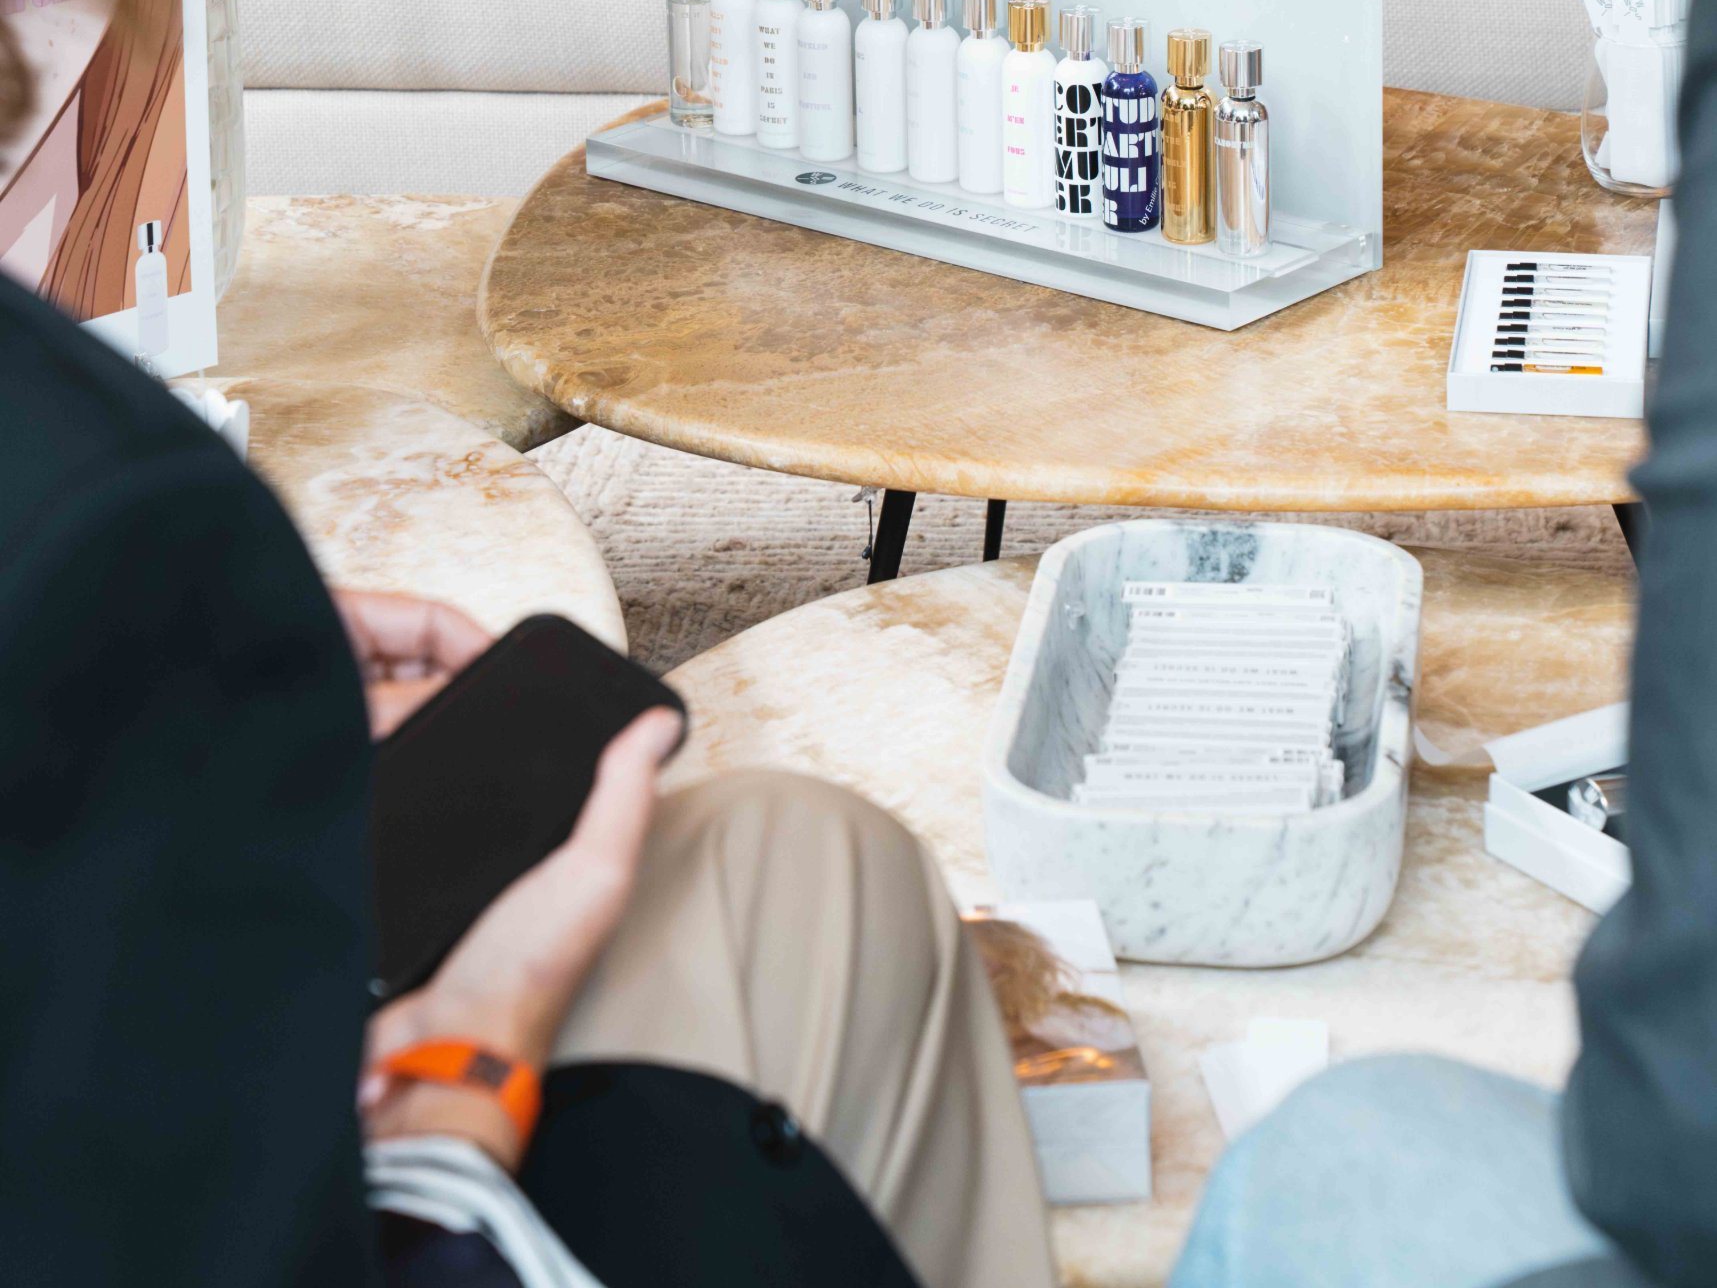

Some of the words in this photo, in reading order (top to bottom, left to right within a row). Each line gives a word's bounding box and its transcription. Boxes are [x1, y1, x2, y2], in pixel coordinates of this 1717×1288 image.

[758, 24, 782, 35] WHAT
[763, 41, 776, 50] WE
[763, 56, 776, 65] DO
[759, 85, 783, 95] PARIS
[767, 101, 776, 109] IS
[759, 114, 788, 125] SECRET
[837, 181, 888, 198] WHAT
[889, 193, 915, 204] WE
[918, 201, 945, 212] DO
[946, 207, 969, 217] IS
[969, 213, 1042, 233] SECRET
[1139, 212, 1150, 226] by
